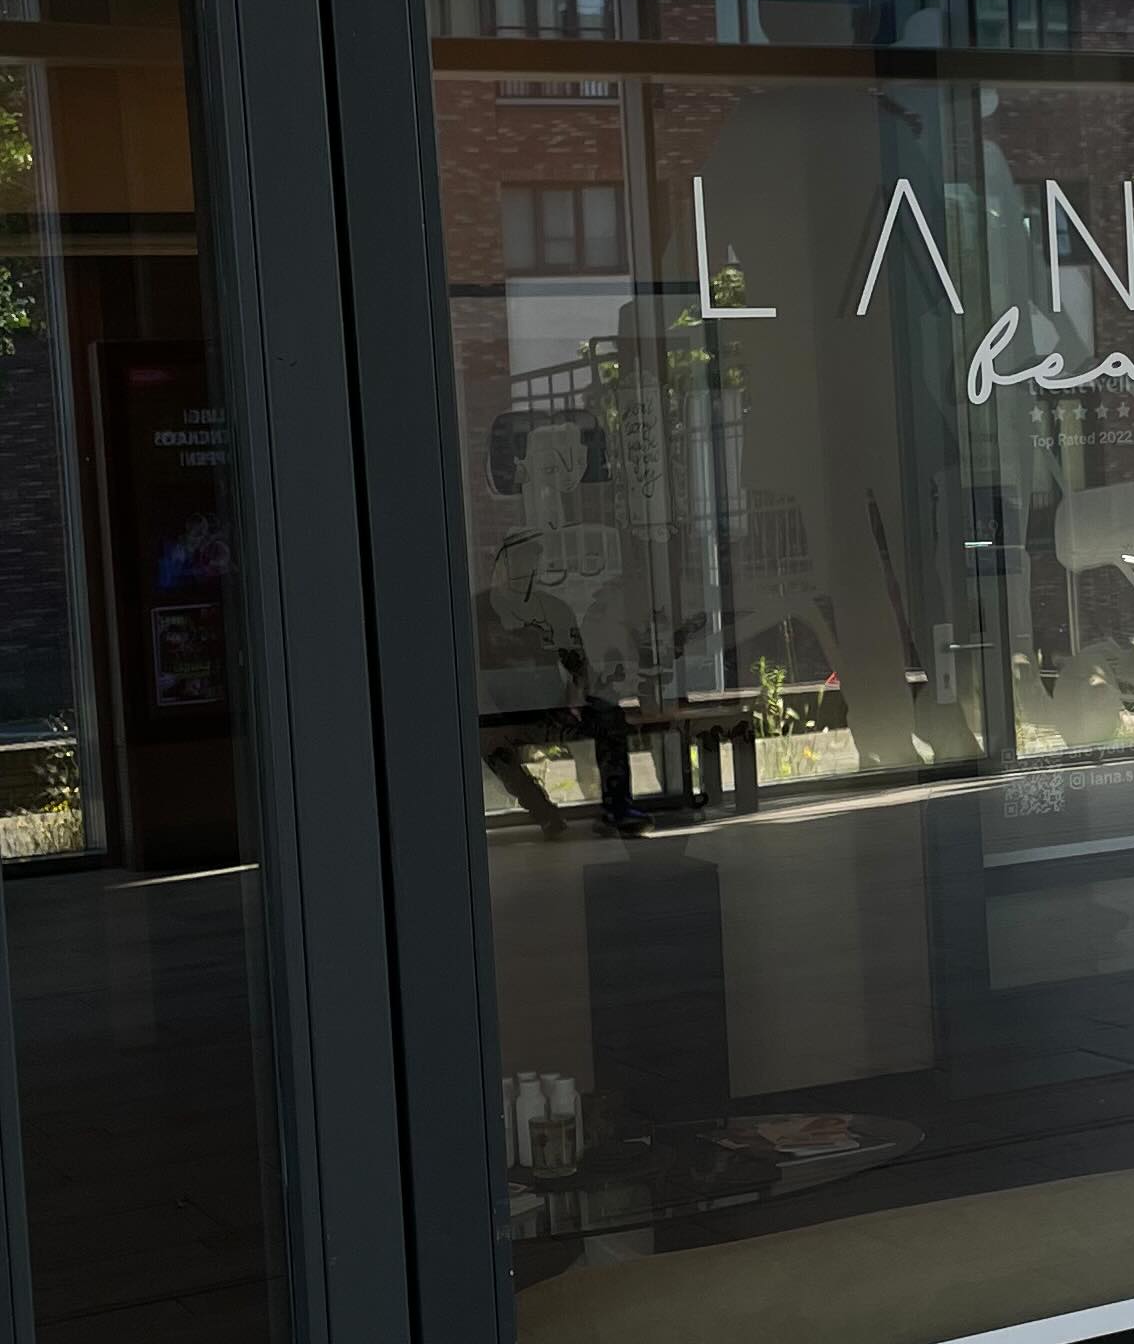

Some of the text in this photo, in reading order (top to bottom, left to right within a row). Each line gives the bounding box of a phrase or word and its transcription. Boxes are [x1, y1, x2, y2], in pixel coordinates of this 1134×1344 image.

[1029, 430, 1133, 449] Top Rated 2022
